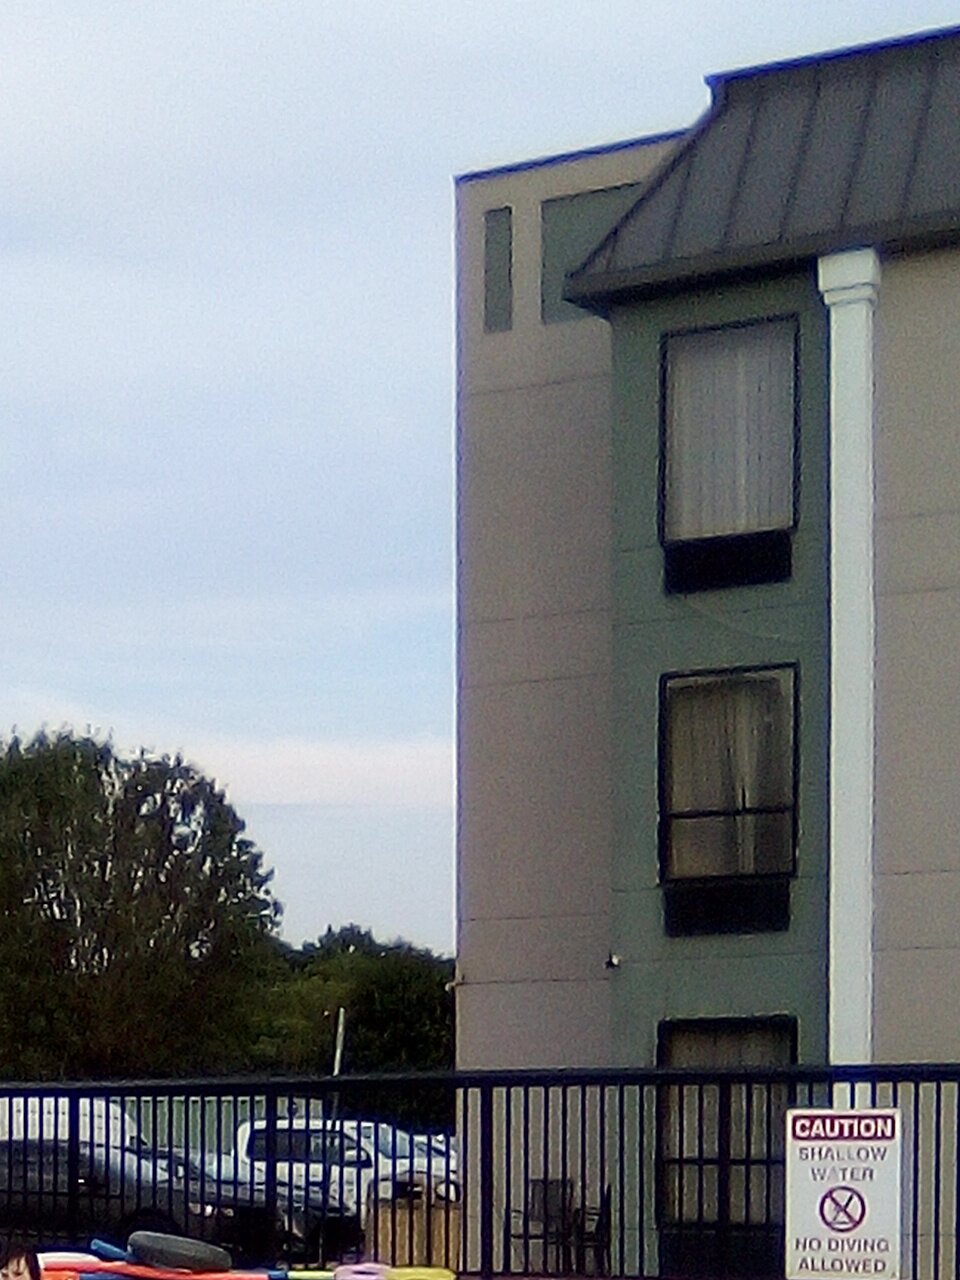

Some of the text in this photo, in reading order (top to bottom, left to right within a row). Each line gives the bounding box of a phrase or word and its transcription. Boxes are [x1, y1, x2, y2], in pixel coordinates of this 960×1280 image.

[795, 1118, 892, 1138] CAUTION
[798, 1146, 888, 1162] SHALLOW
[811, 1166, 875, 1182] WATER
[795, 1237, 890, 1252] NO DIVING
[798, 1258, 887, 1274] ALLOWED
